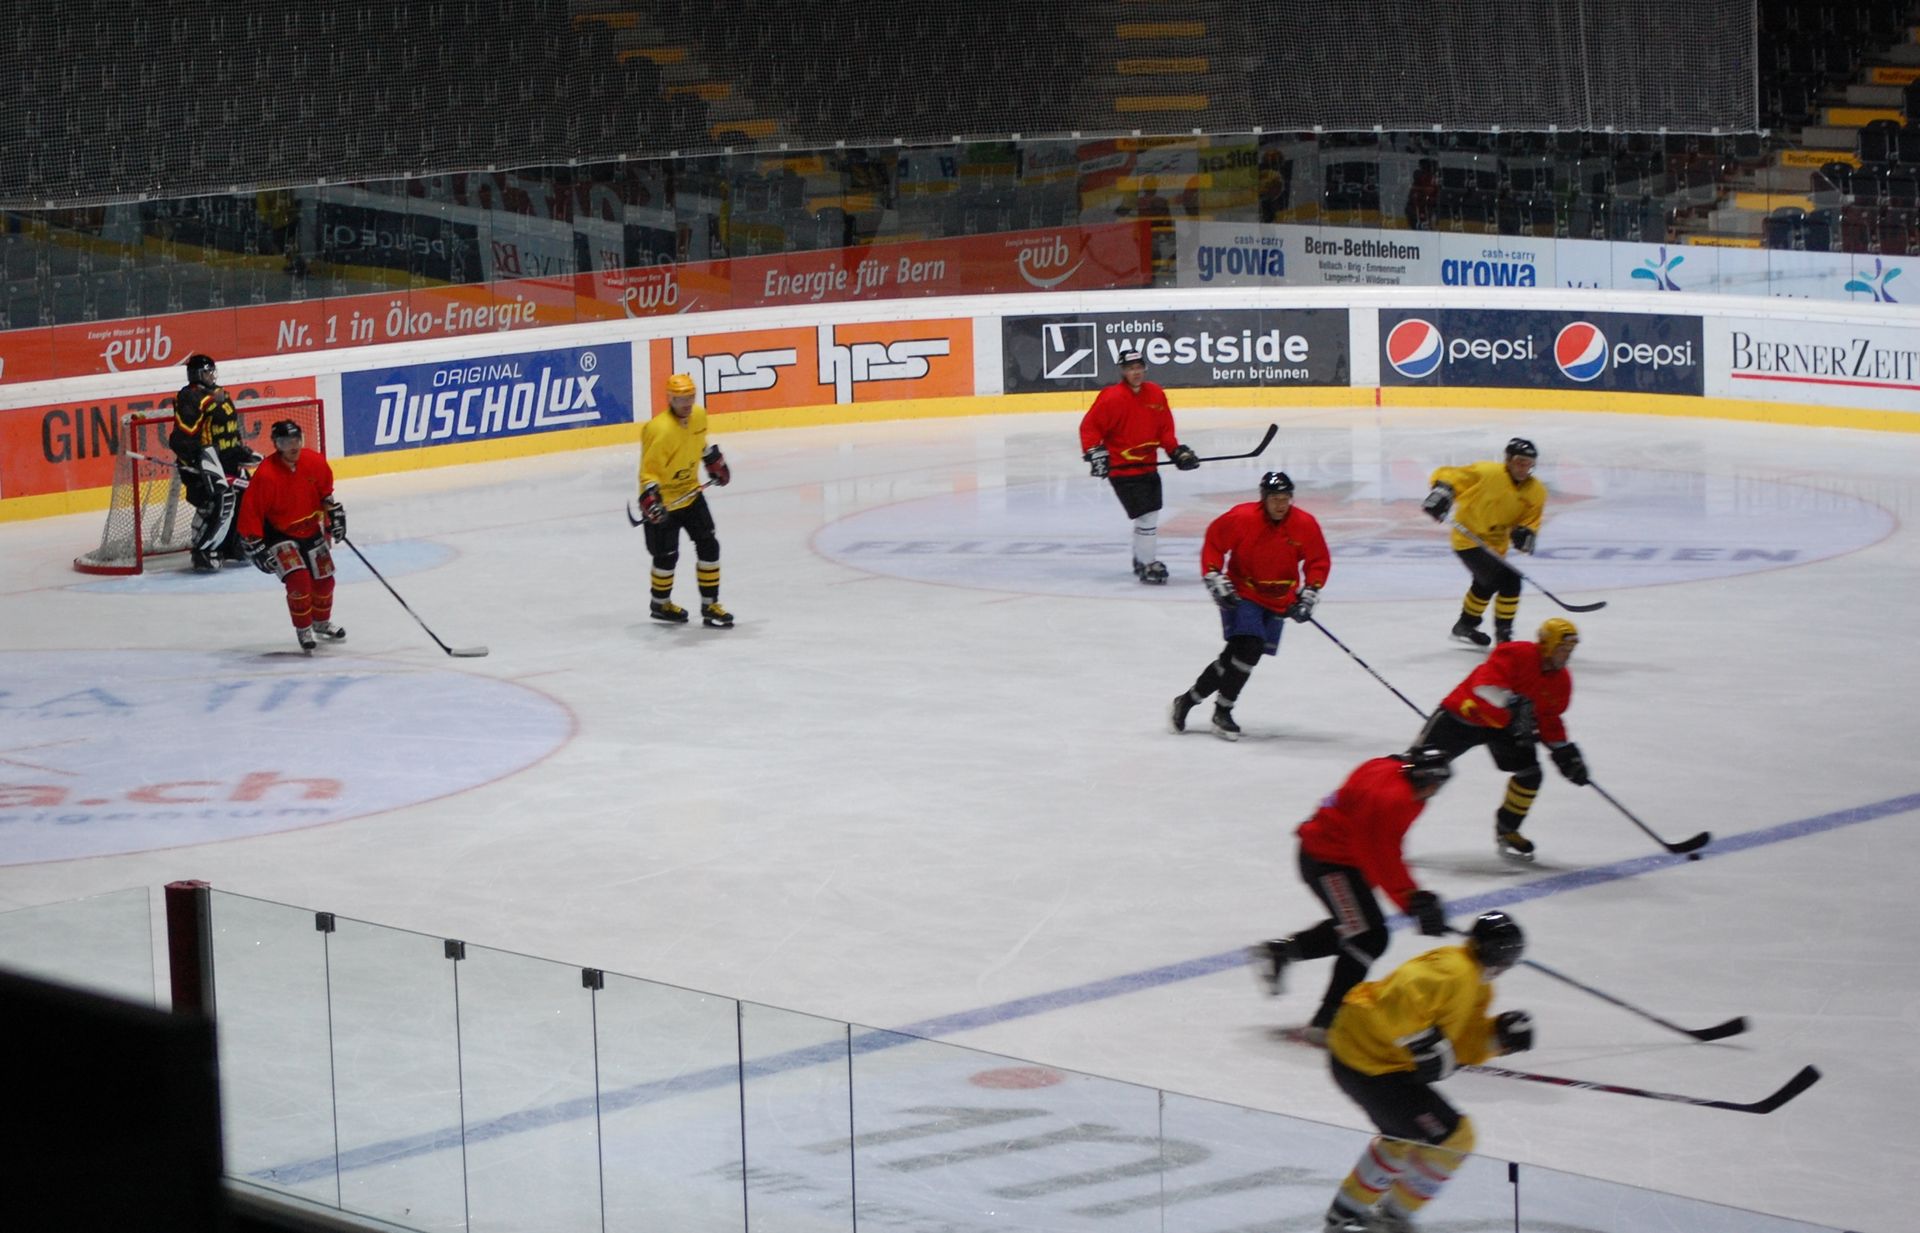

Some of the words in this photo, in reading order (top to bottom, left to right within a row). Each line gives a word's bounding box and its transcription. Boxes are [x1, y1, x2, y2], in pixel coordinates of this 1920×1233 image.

[1014, 236, 1072, 278] ewb
[1198, 245, 1285, 281] growa
[1305, 236, 1421, 260] Bern-Bethlehem
[617, 272, 681, 315] ewb
[763, 263, 847, 299] Energie
[854, 260, 890, 294] für
[897, 257, 945, 285] Bern
[277, 318, 313, 350] Nr.
[325, 314, 338, 344] 1
[351, 311, 375, 342] in
[386, 294, 537, 337] Öko-Energie
[1105, 319, 1164, 334] erlebnis
[101, 325, 173, 373] ewb
[1106, 330, 1309, 365] westside
[1449, 335, 1534, 364] pepsi
[1614, 341, 1692, 370] pepsi
[433, 362, 523, 388] ORIGINAL
[1212, 366, 1245, 380] bern
[1249, 365, 1309, 381] brünnen
